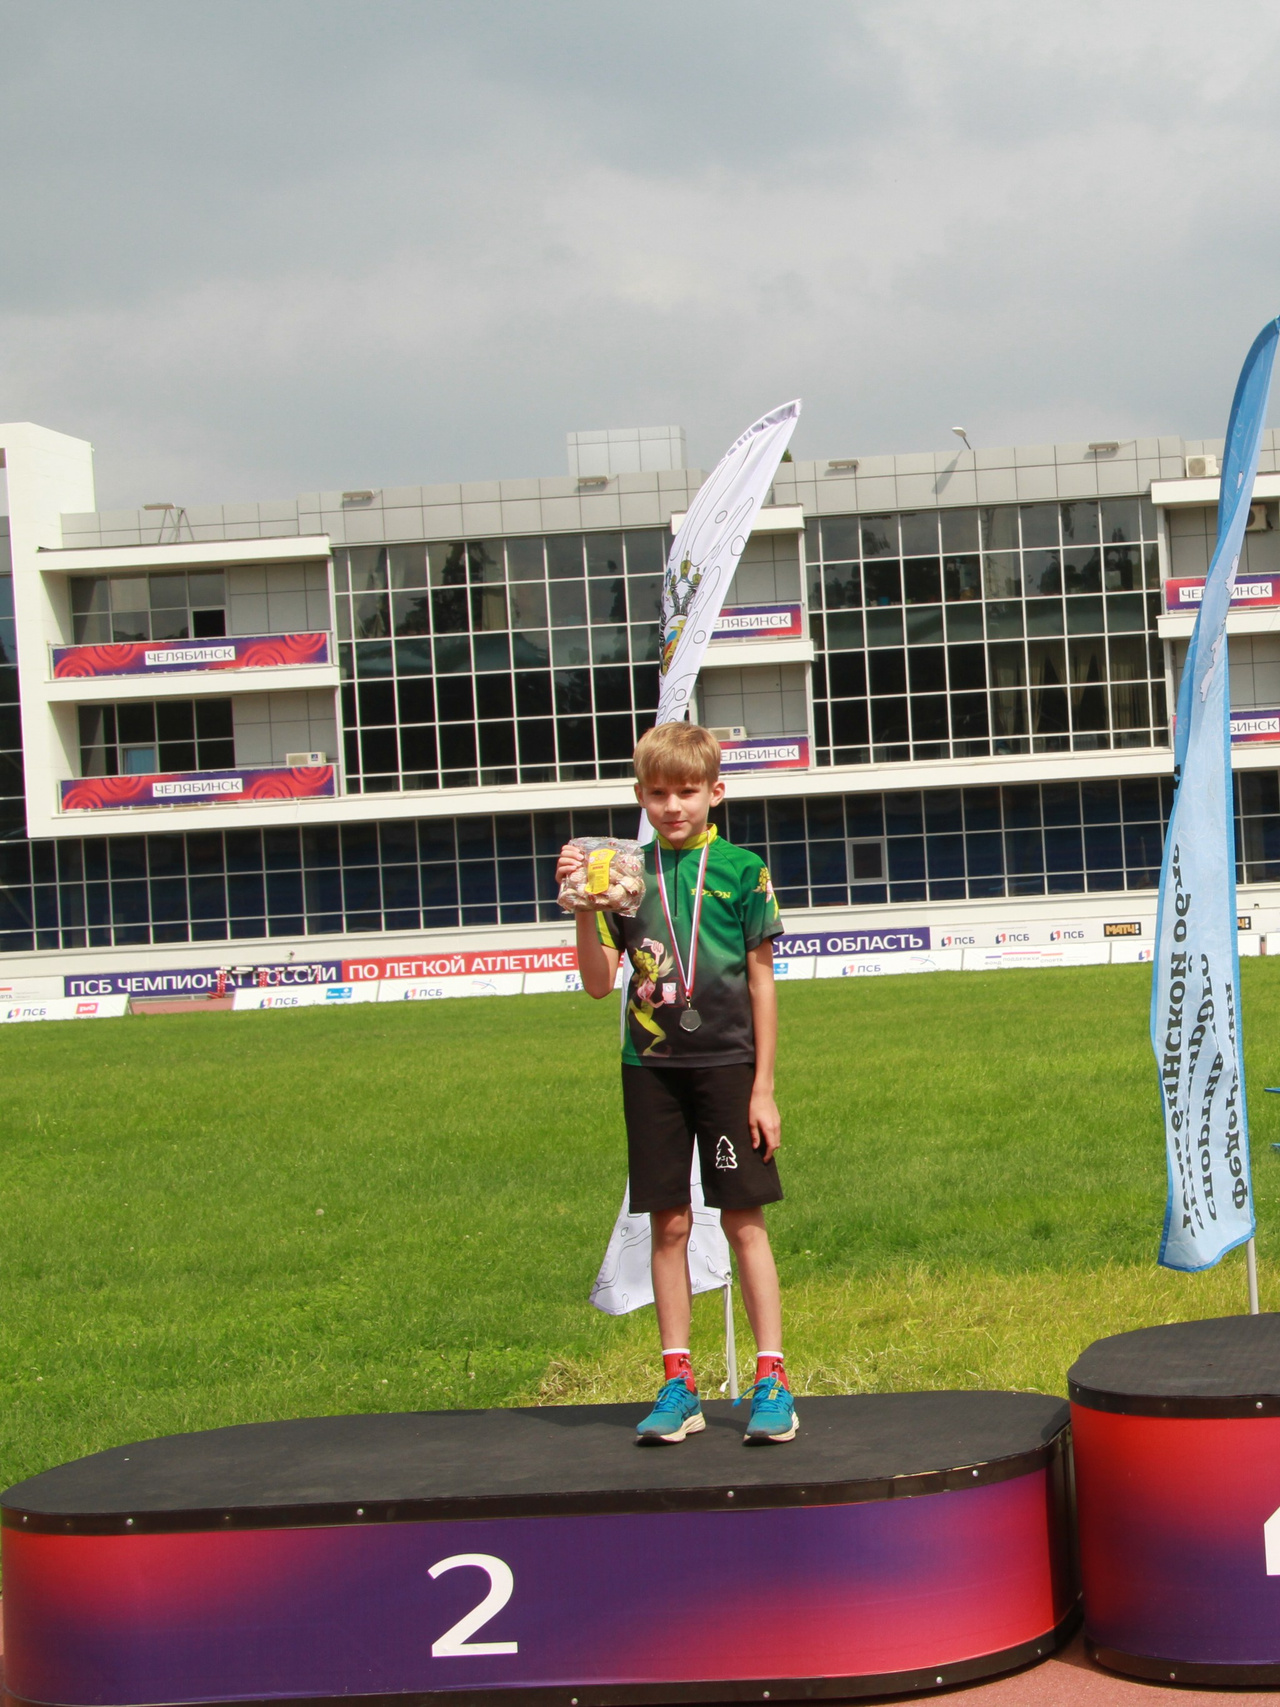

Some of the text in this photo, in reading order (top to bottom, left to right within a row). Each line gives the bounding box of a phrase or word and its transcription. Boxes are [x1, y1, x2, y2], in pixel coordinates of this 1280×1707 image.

[1181, 585, 1270, 599] ЧЕИНСК
[713, 615, 789, 630] ЕЛЯБИНСК
[147, 647, 234, 663] ЧЕЛЯБИНСК
[1229, 720, 1277, 732] БИНСК
[721, 747, 797, 761] ЕЛЯБИНСК
[155, 779, 241, 795] ЧЕЛЯБИНСК
[954, 936, 976, 946] ПСБ
[1008, 933, 1030, 943] ПСБ
[1063, 930, 1085, 940] ПСБ
[826, 934, 923, 953] ОБЛАСТЬ
[70, 979, 113, 996] ПСБ
[349, 963, 379, 980] ПО
[384, 956, 466, 978] ЛЕГКОЙ
[471, 952, 575, 972] АТЛЕТИКЕ
[857, 964, 881, 973] ПСБ
[419, 988, 443, 998] ПСБ
[275, 997, 298, 1006] ПСБ
[22, 1008, 47, 1017] ПСБ
[427, 1552, 519, 1658] 2
